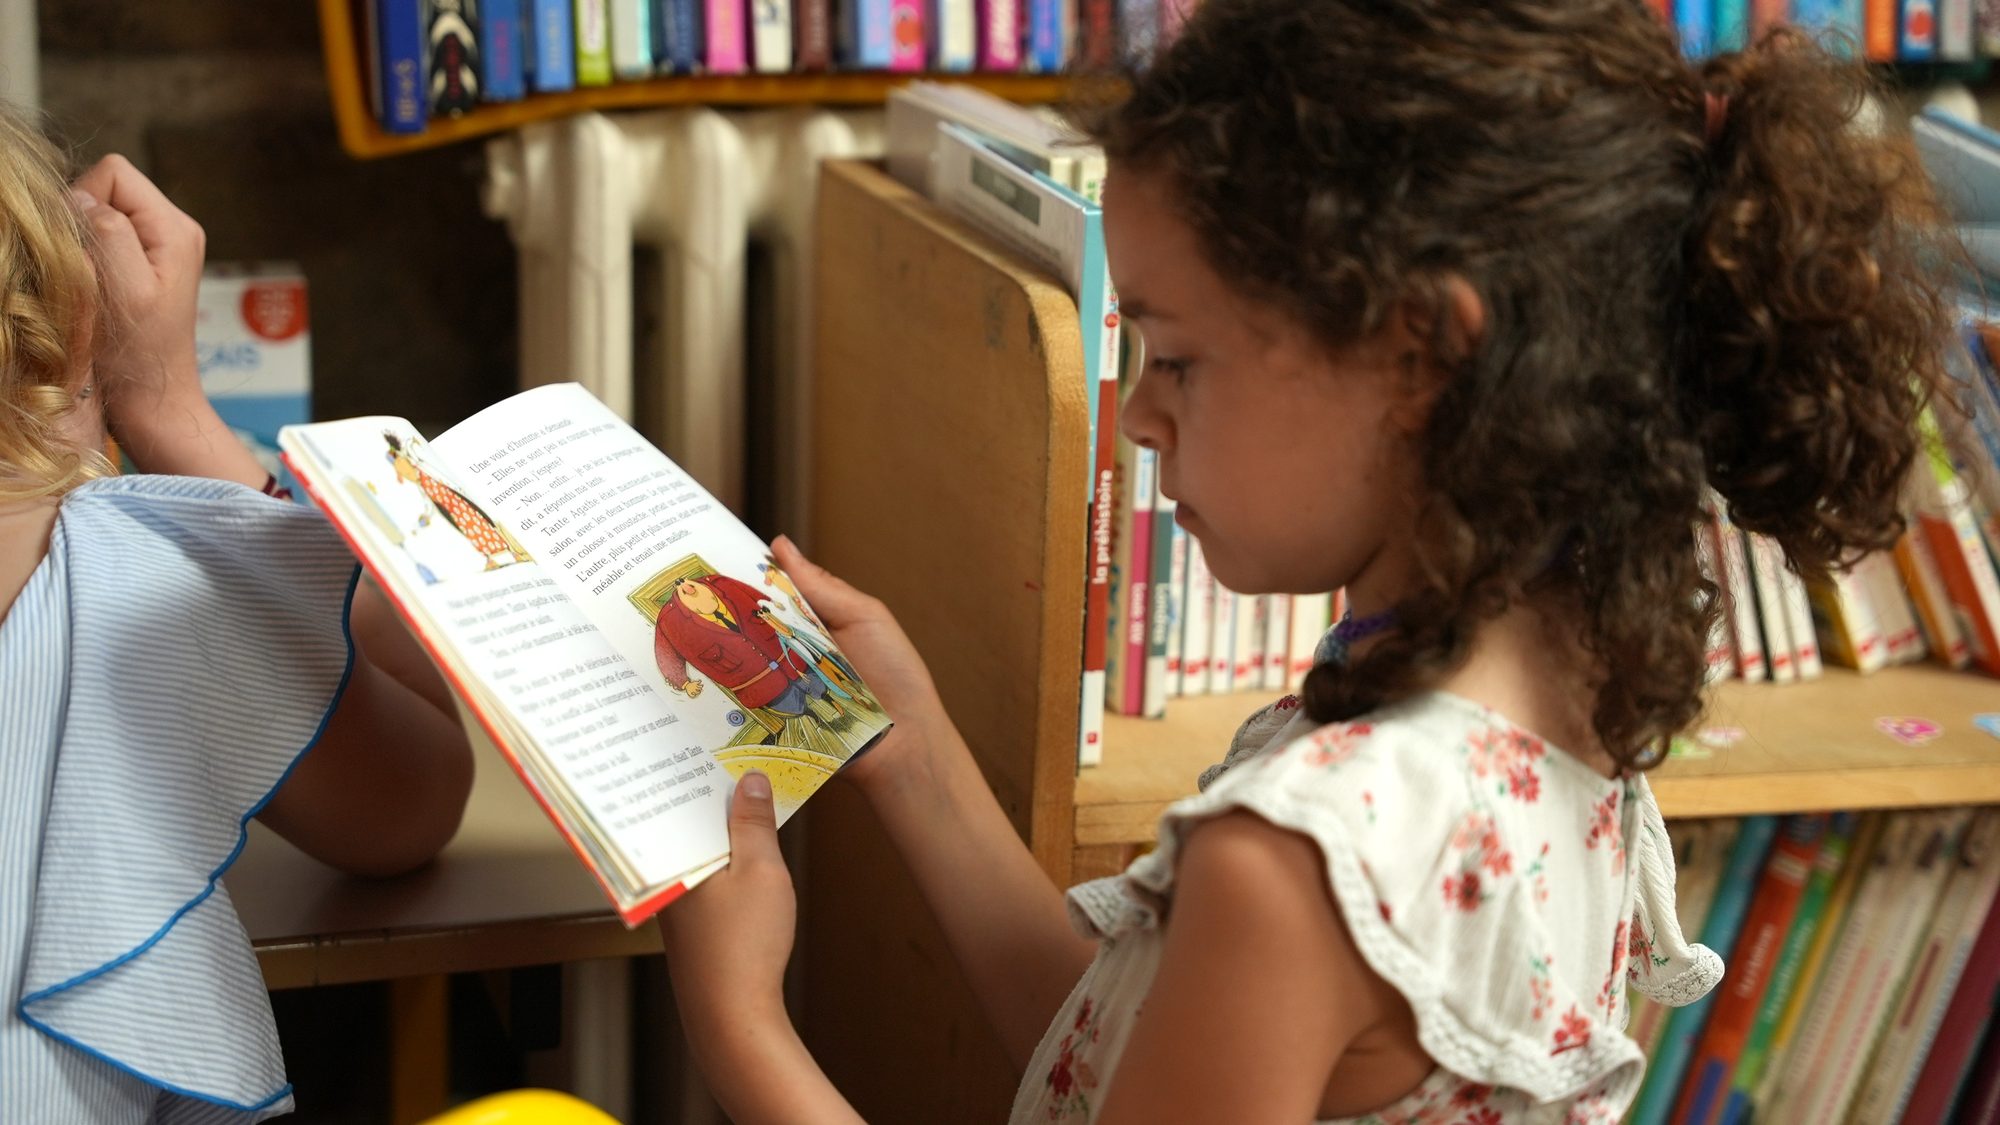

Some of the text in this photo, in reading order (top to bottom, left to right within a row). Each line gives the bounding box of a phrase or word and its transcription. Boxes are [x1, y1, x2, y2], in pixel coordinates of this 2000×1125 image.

[469, 459, 491, 474] Une
[490, 448, 508, 461] voix
[506, 431, 540, 452] d'homme
[491, 465, 516, 481] Elles
[515, 459, 528, 468] ne
[527, 448, 544, 460] sont
[544, 442, 558, 454] pas
[490, 477, 534, 506] invention,
[520, 518, 538, 530] dit,
[544, 491, 576, 514] répondu
[575, 485, 588, 494] ma
[541, 517, 570, 536] Tante
[570, 498, 600, 519] Agathe
[549, 536, 577, 557] salon,
[575, 522, 595, 537] avec
[592, 515, 606, 524] les
[605, 504, 624, 517] deux
[1092, 469, 1112, 585] la préhistoire
[564, 558, 578, 569] un
[578, 536, 607, 559] colosse
[604, 530, 614, 538] à
[576, 558, 612, 583] L'autre,
[608, 545, 626, 561] plus
[624, 534, 642, 550] petit
[592, 568, 624, 596] méable
[624, 561, 634, 570] et
[632, 547, 655, 564] tenait
[653, 541, 668, 552] une
[693, 765, 708, 776] trop
[706, 760, 716, 771] de
